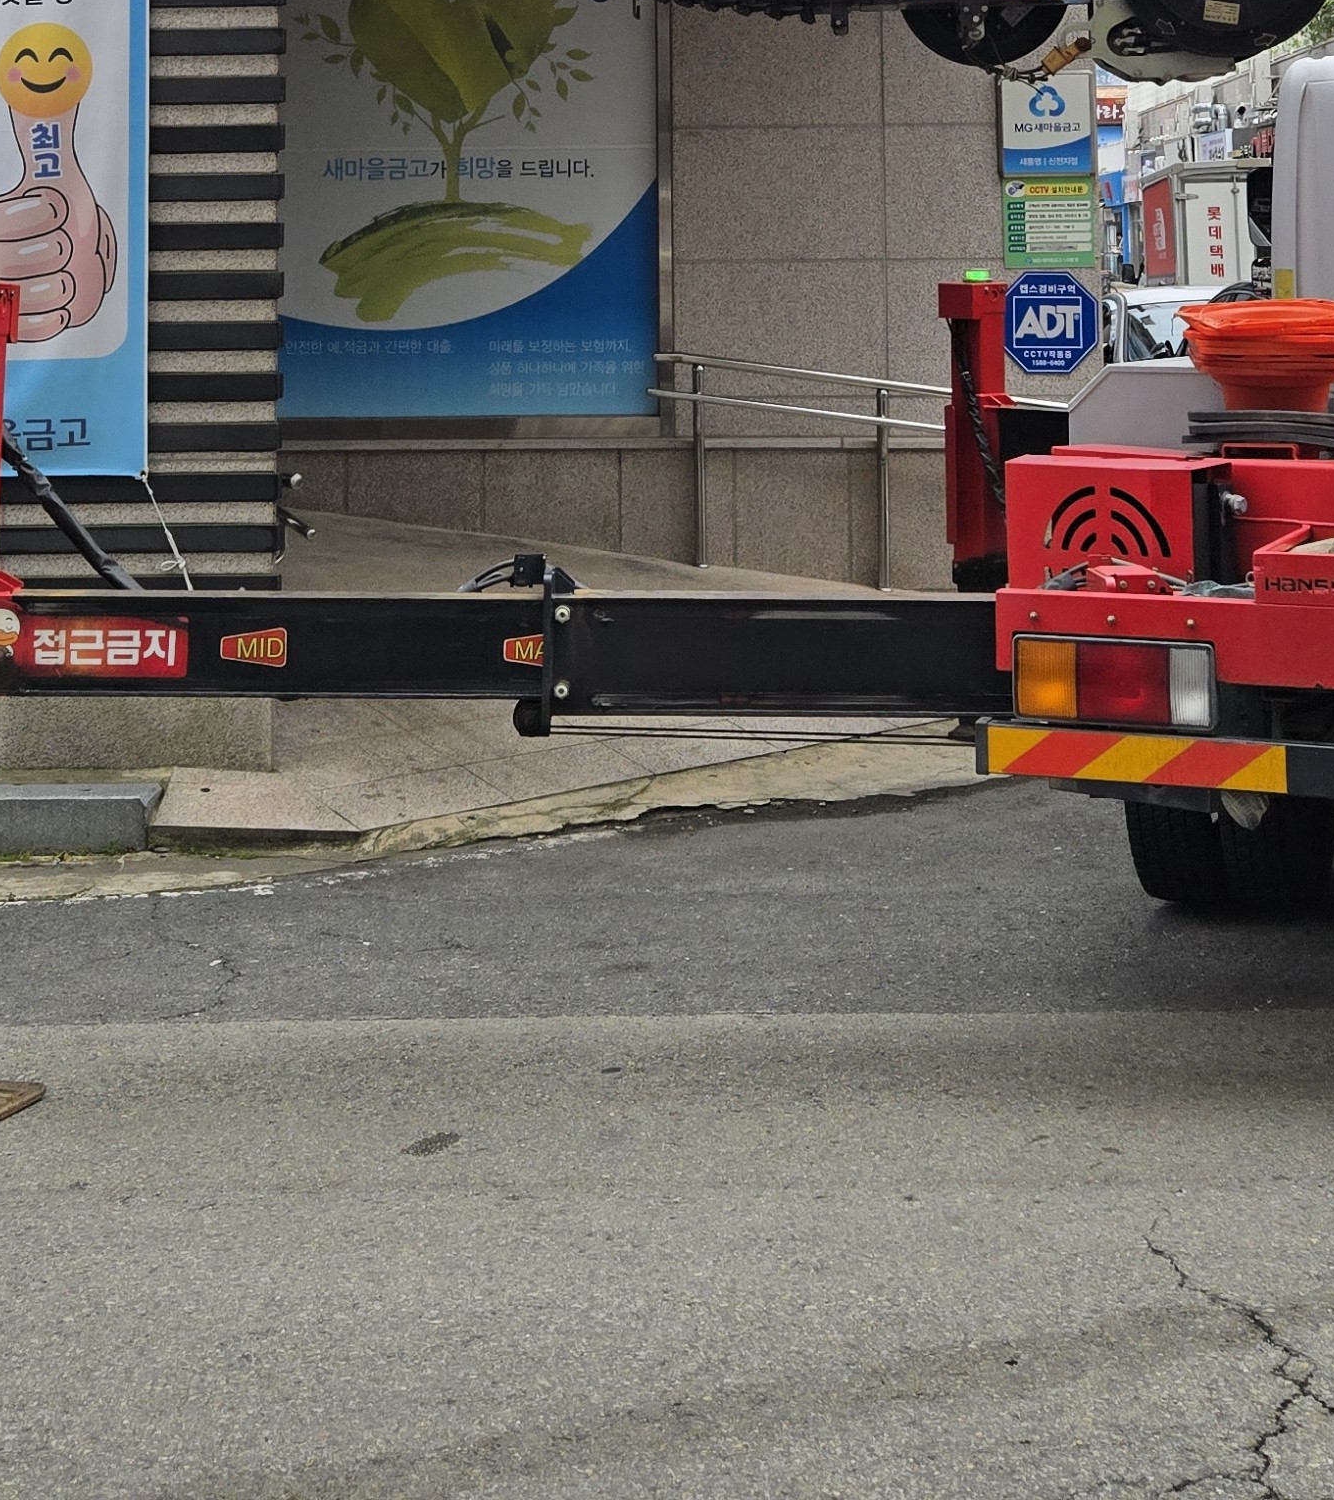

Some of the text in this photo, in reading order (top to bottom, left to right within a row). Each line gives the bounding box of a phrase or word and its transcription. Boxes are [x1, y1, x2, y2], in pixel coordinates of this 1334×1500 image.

[322, 156, 595, 181] 새마을금고가 희망을 드립니다.
[1029, 186, 1049, 194] CCTV
[1015, 305, 1081, 339] ADT
[32, 624, 178, 668] 접근금지
[237, 635, 285, 660] MID
